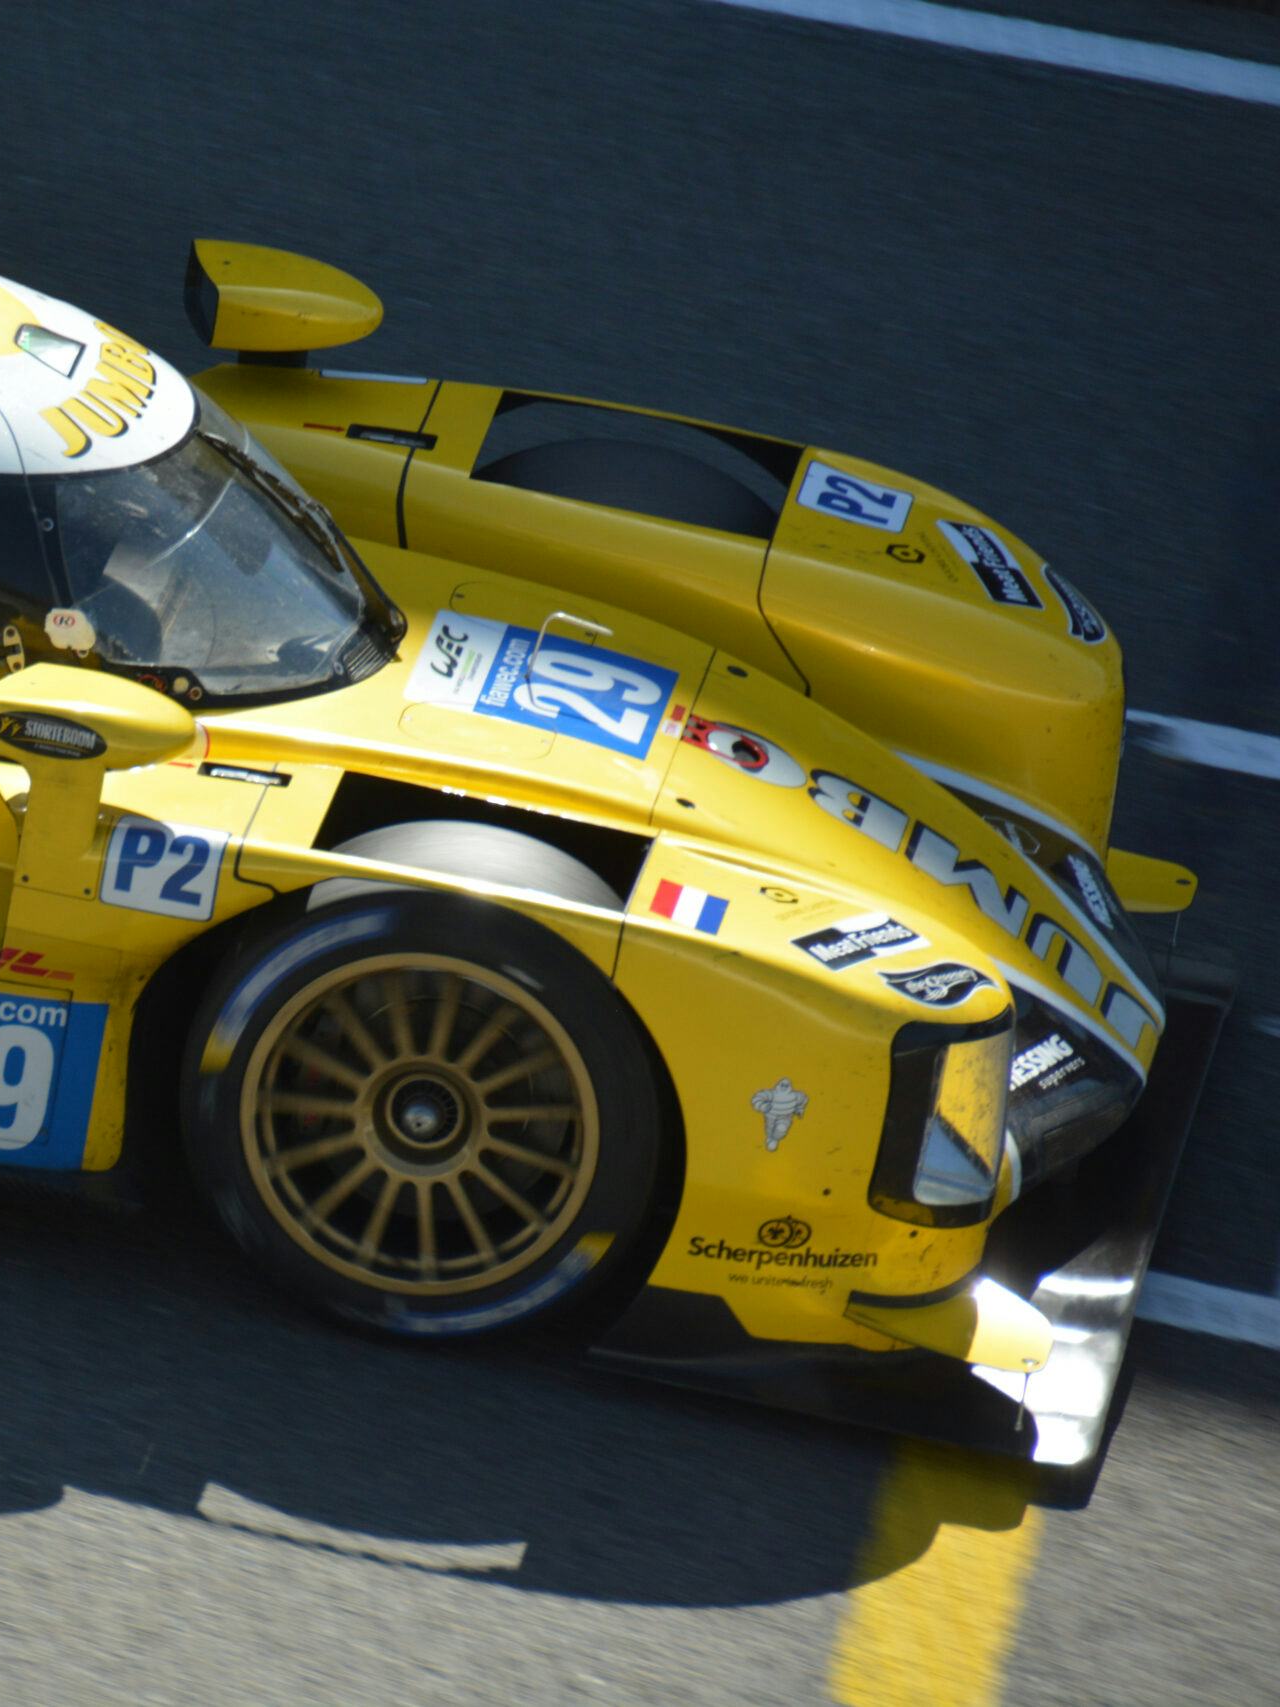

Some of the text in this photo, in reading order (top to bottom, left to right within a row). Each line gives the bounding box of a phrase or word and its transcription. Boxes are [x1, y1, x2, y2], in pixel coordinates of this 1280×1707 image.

[38, 319, 157, 459] JUMBO
[816, 475, 897, 525] P2
[431, 624, 469, 679] WEC
[480, 637, 531, 708] fiawec.com
[513, 649, 662, 745] 29
[24, 720, 96, 750] STORTEBOOM
[113, 826, 211, 907] P2
[688, 1236, 878, 1270] Scherpenhuizen
